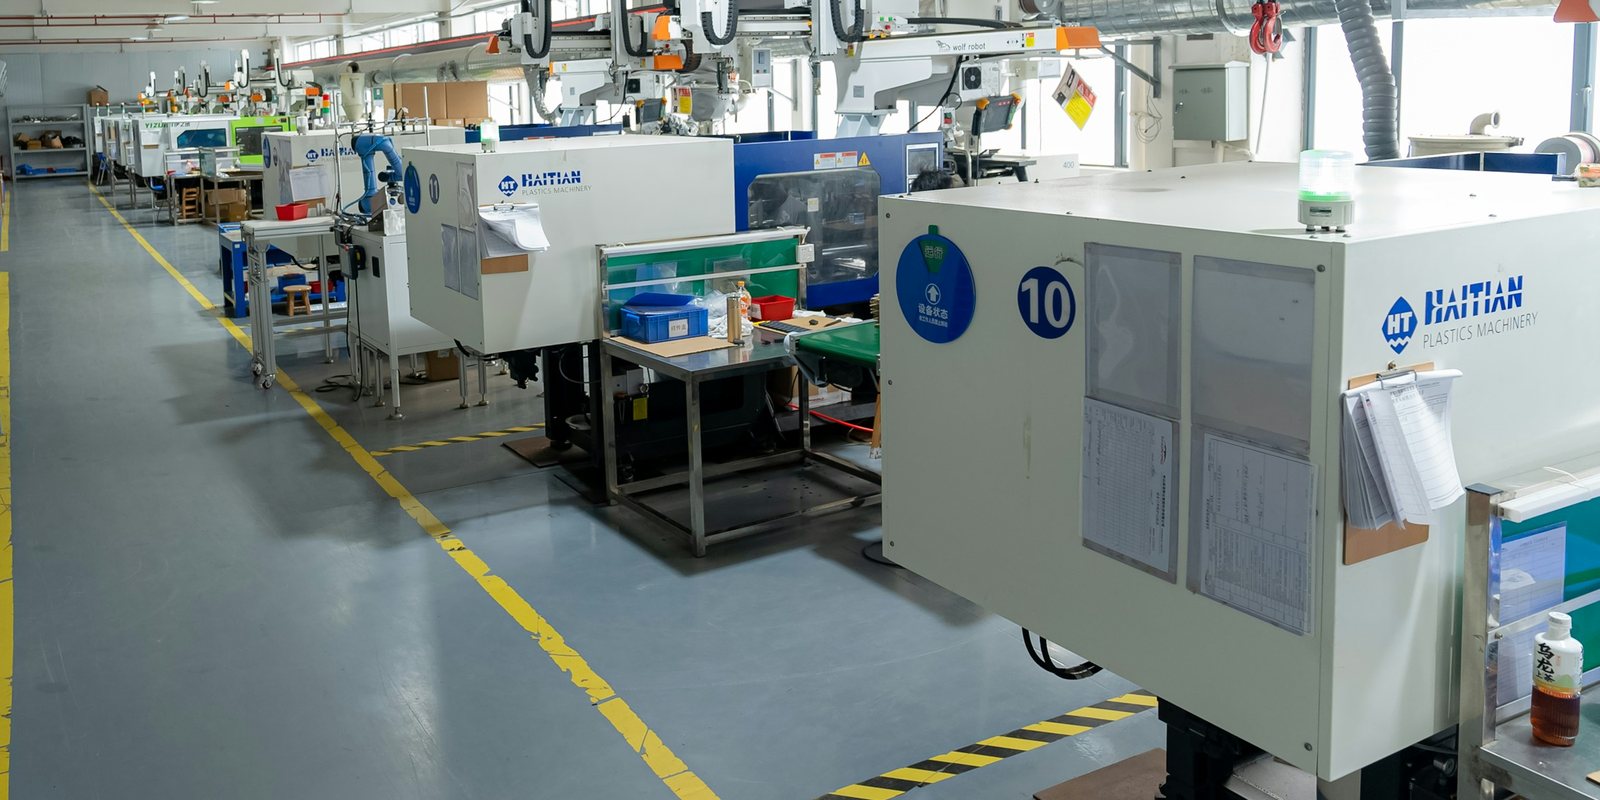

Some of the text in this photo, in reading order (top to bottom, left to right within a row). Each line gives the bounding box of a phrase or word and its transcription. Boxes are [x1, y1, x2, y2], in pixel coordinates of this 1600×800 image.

[953, 42, 986, 51] wolf robot
[1062, 160, 1075, 169] 400
[500, 180, 515, 191] HT
[521, 170, 581, 187] HAITIAN
[430, 178, 438, 200] 11
[521, 184, 592, 197] PLASTICS MACHINERY
[1021, 277, 1071, 329] 10
[1424, 275, 1523, 326] HAITIAN
[918, 303, 949, 320] 设备状态
[1387, 311, 1413, 336] HT
[1423, 311, 1539, 349] PLASTICS MACHINERY
